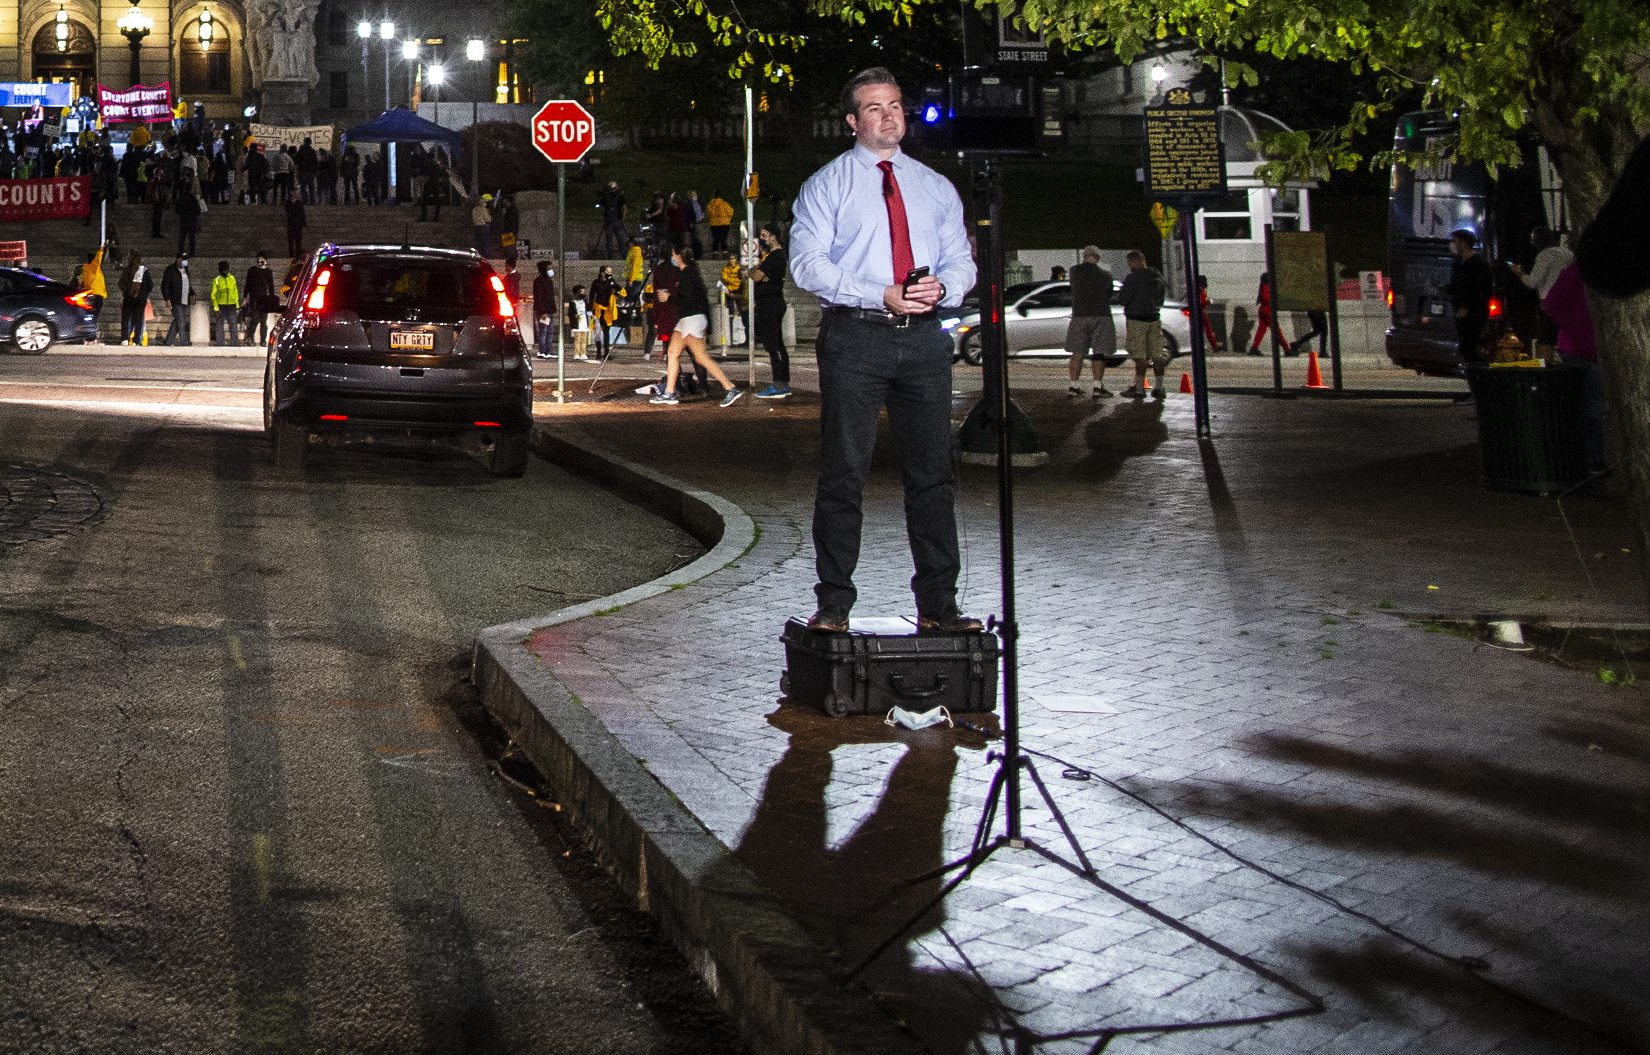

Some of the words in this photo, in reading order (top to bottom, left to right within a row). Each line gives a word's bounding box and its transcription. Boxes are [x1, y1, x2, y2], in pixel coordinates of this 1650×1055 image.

[997, 50, 1020, 62] STATE
[1021, 50, 1049, 62] STREET
[13, 83, 48, 96] COUNT
[101, 90, 141, 103] EVERYONE
[141, 89, 168, 101] COUNTS
[103, 105, 130, 116] COUNT
[131, 104, 170, 117] EVERYONE
[536, 119, 590, 143] STOP
[393, 334, 407, 344] NTY
[411, 334, 432, 345] GRTY
